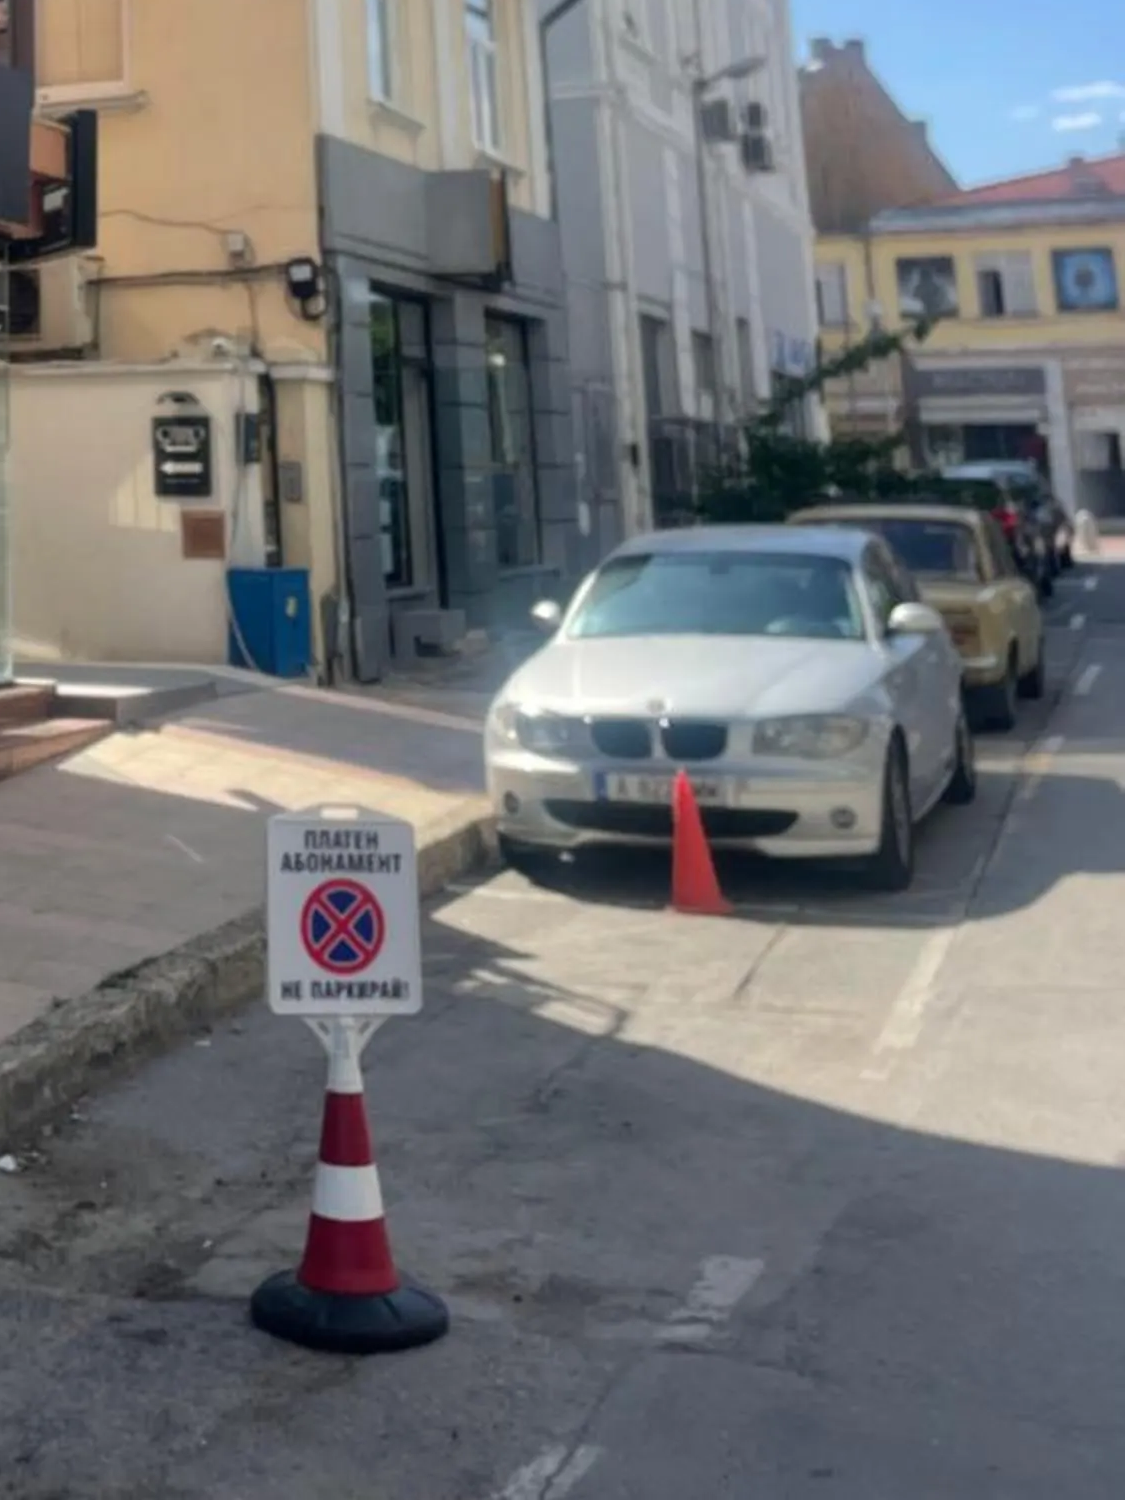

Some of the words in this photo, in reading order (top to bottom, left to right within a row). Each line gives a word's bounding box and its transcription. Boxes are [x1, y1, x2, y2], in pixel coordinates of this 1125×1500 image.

[304, 830, 379, 850] ПЛАТЕН
[280, 852, 402, 874] АБОНАМЕНТ
[281, 980, 301, 1000] НЕ
